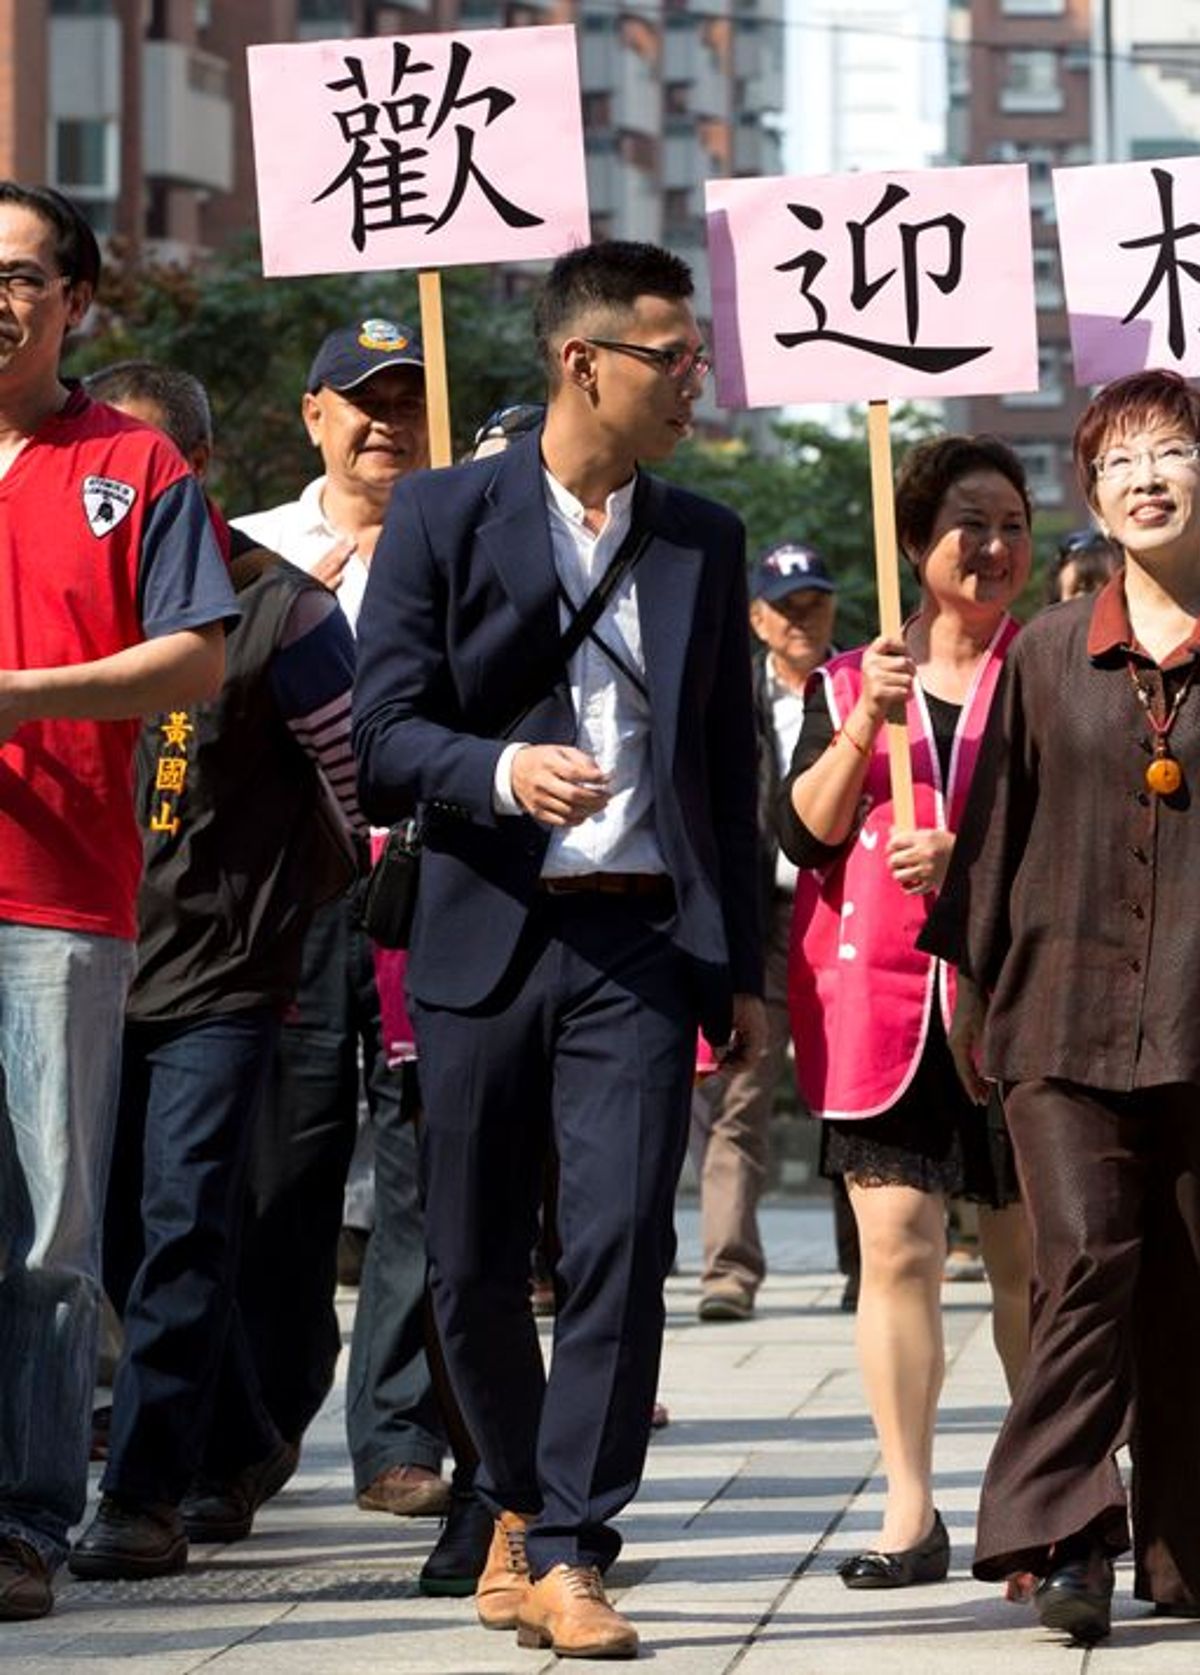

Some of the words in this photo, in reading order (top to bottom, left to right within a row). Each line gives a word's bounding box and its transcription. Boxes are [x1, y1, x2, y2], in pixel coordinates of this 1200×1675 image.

[312, 41, 545, 253] 歡
[775, 184, 992, 373] 迎
[150, 711, 194, 838] 黃國山
